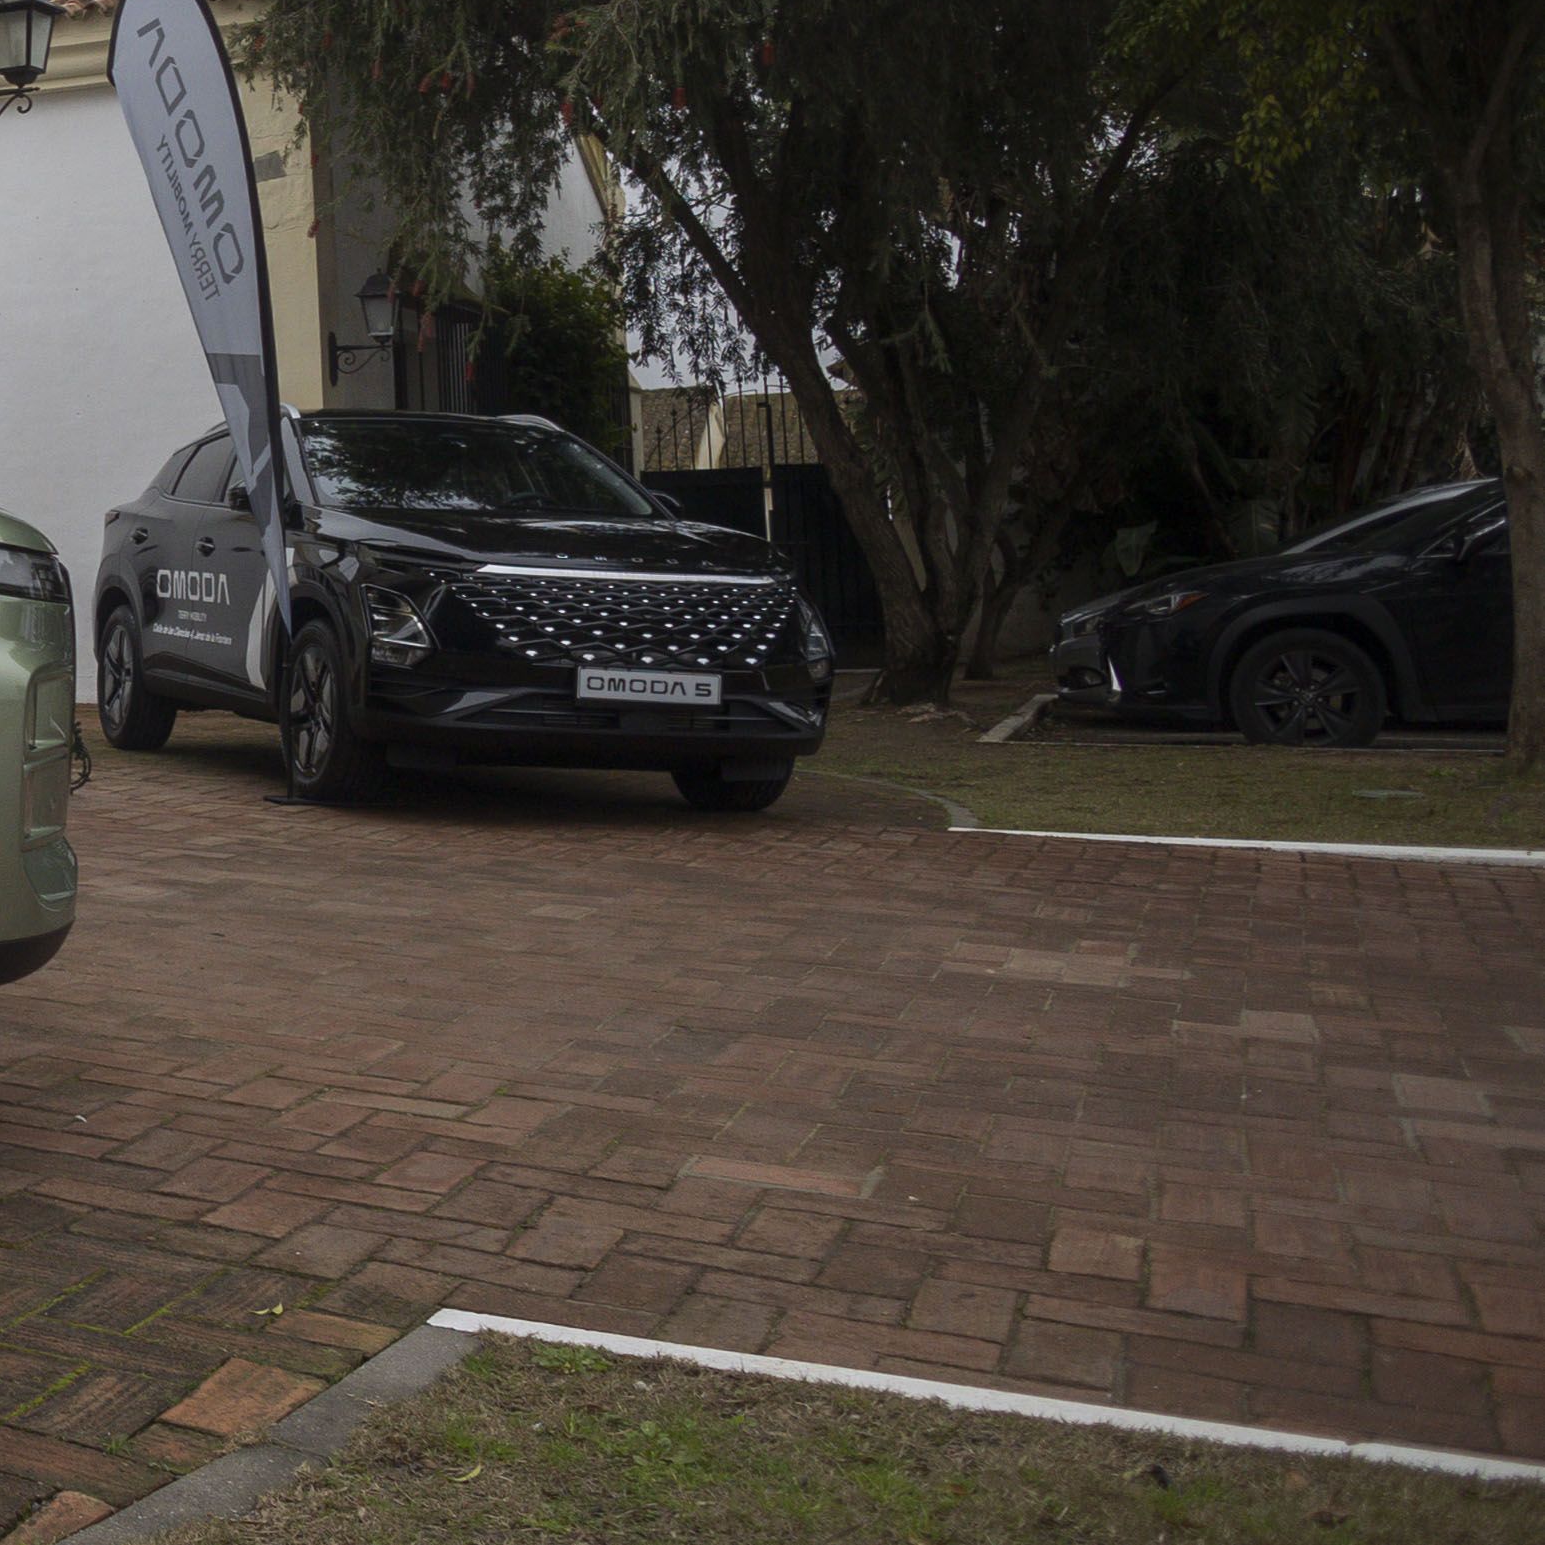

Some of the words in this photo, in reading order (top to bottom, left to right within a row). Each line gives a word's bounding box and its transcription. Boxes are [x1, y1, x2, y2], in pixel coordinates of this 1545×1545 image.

[156, 569, 230, 605] OMODA
[587, 676, 686, 696] OMODA
[695, 683, 711, 697] 5
